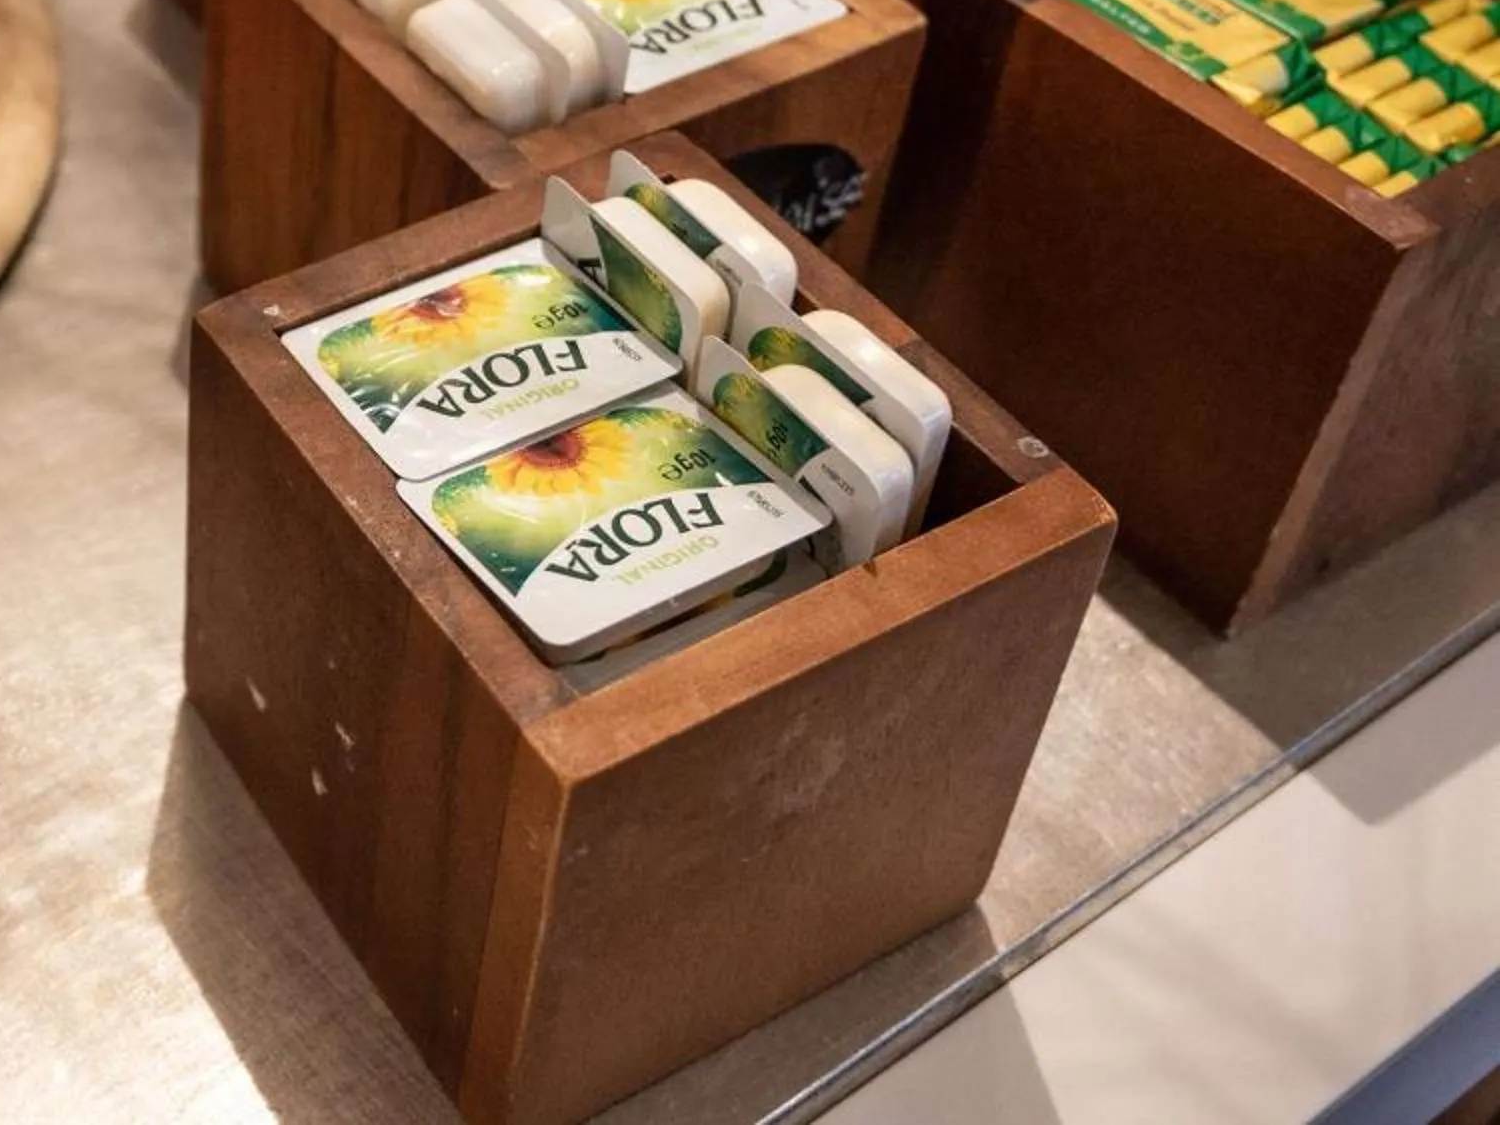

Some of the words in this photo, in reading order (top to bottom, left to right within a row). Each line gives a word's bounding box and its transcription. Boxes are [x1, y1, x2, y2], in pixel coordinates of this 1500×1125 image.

[416, 339, 588, 418] FLORA
[483, 377, 580, 421] ORIGINAL
[544, 492, 725, 582] FLORA
[614, 535, 720, 585] ORIGINAL
